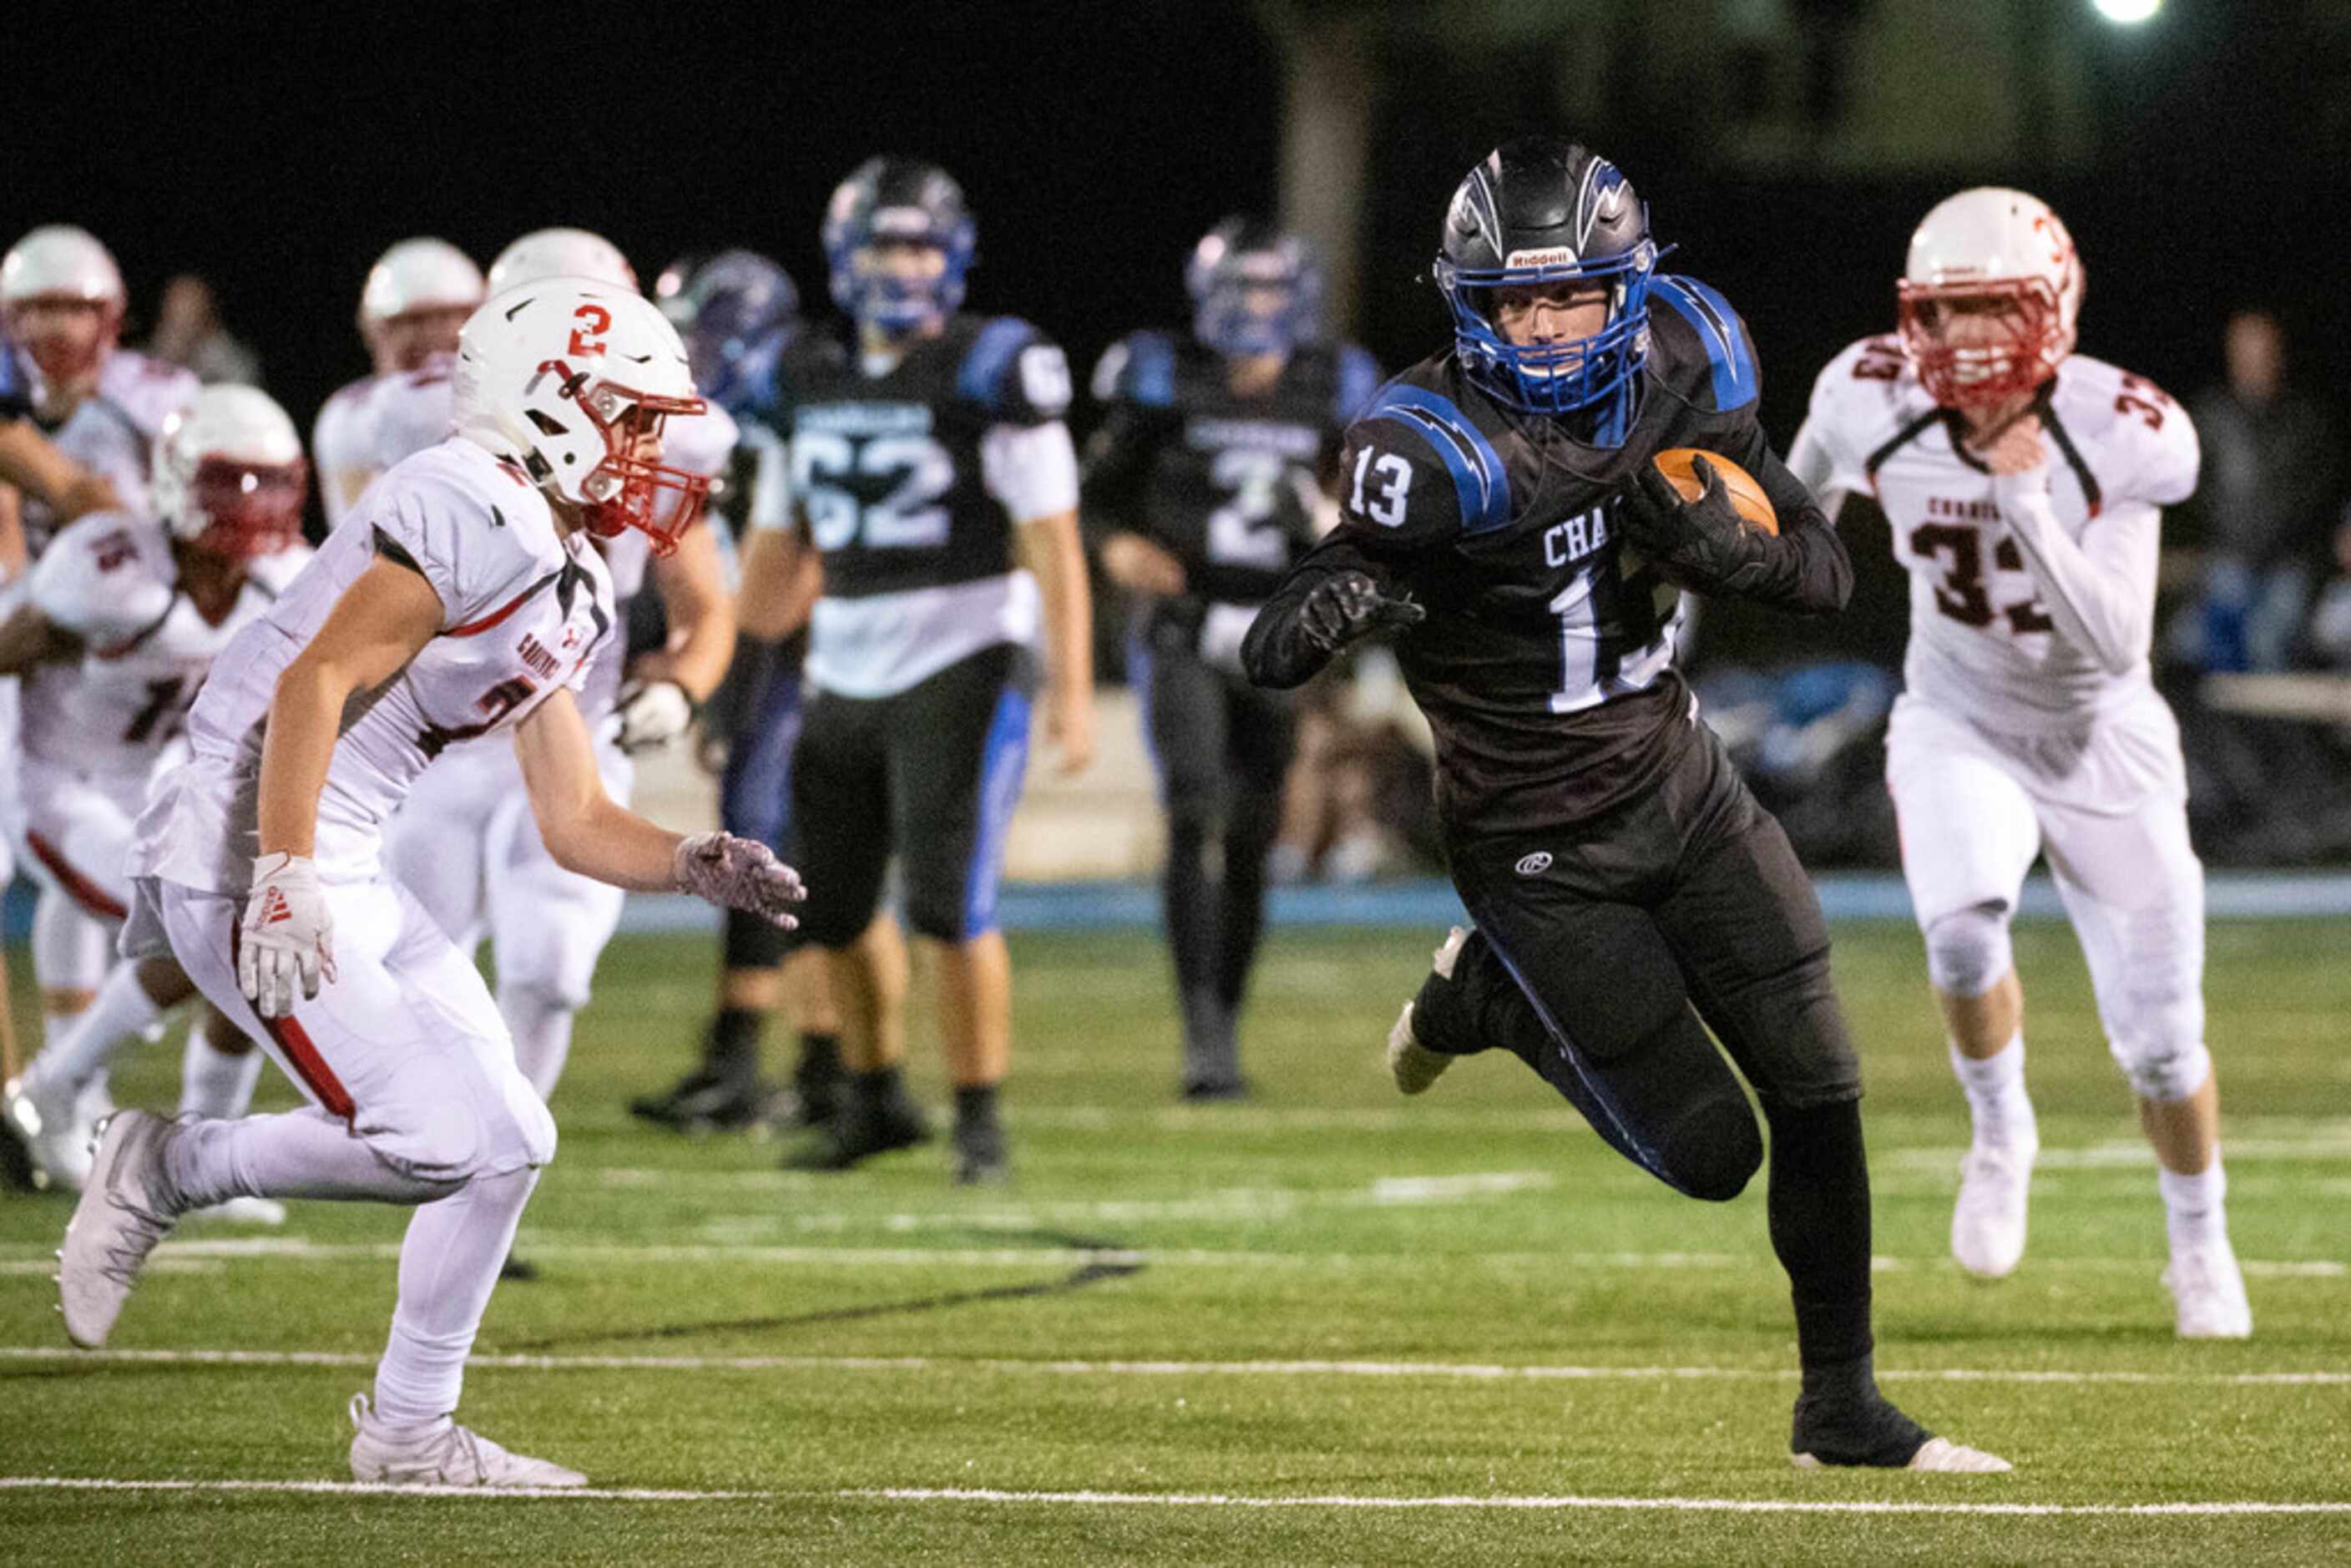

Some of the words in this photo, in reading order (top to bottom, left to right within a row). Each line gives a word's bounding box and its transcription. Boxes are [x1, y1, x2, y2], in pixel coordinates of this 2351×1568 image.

[1512, 253, 1568, 266] Riddell
[568, 304, 612, 357] 2
[791, 429, 955, 551] 62
[1207, 451, 1287, 571] 2
[1349, 445, 1413, 528] 13
